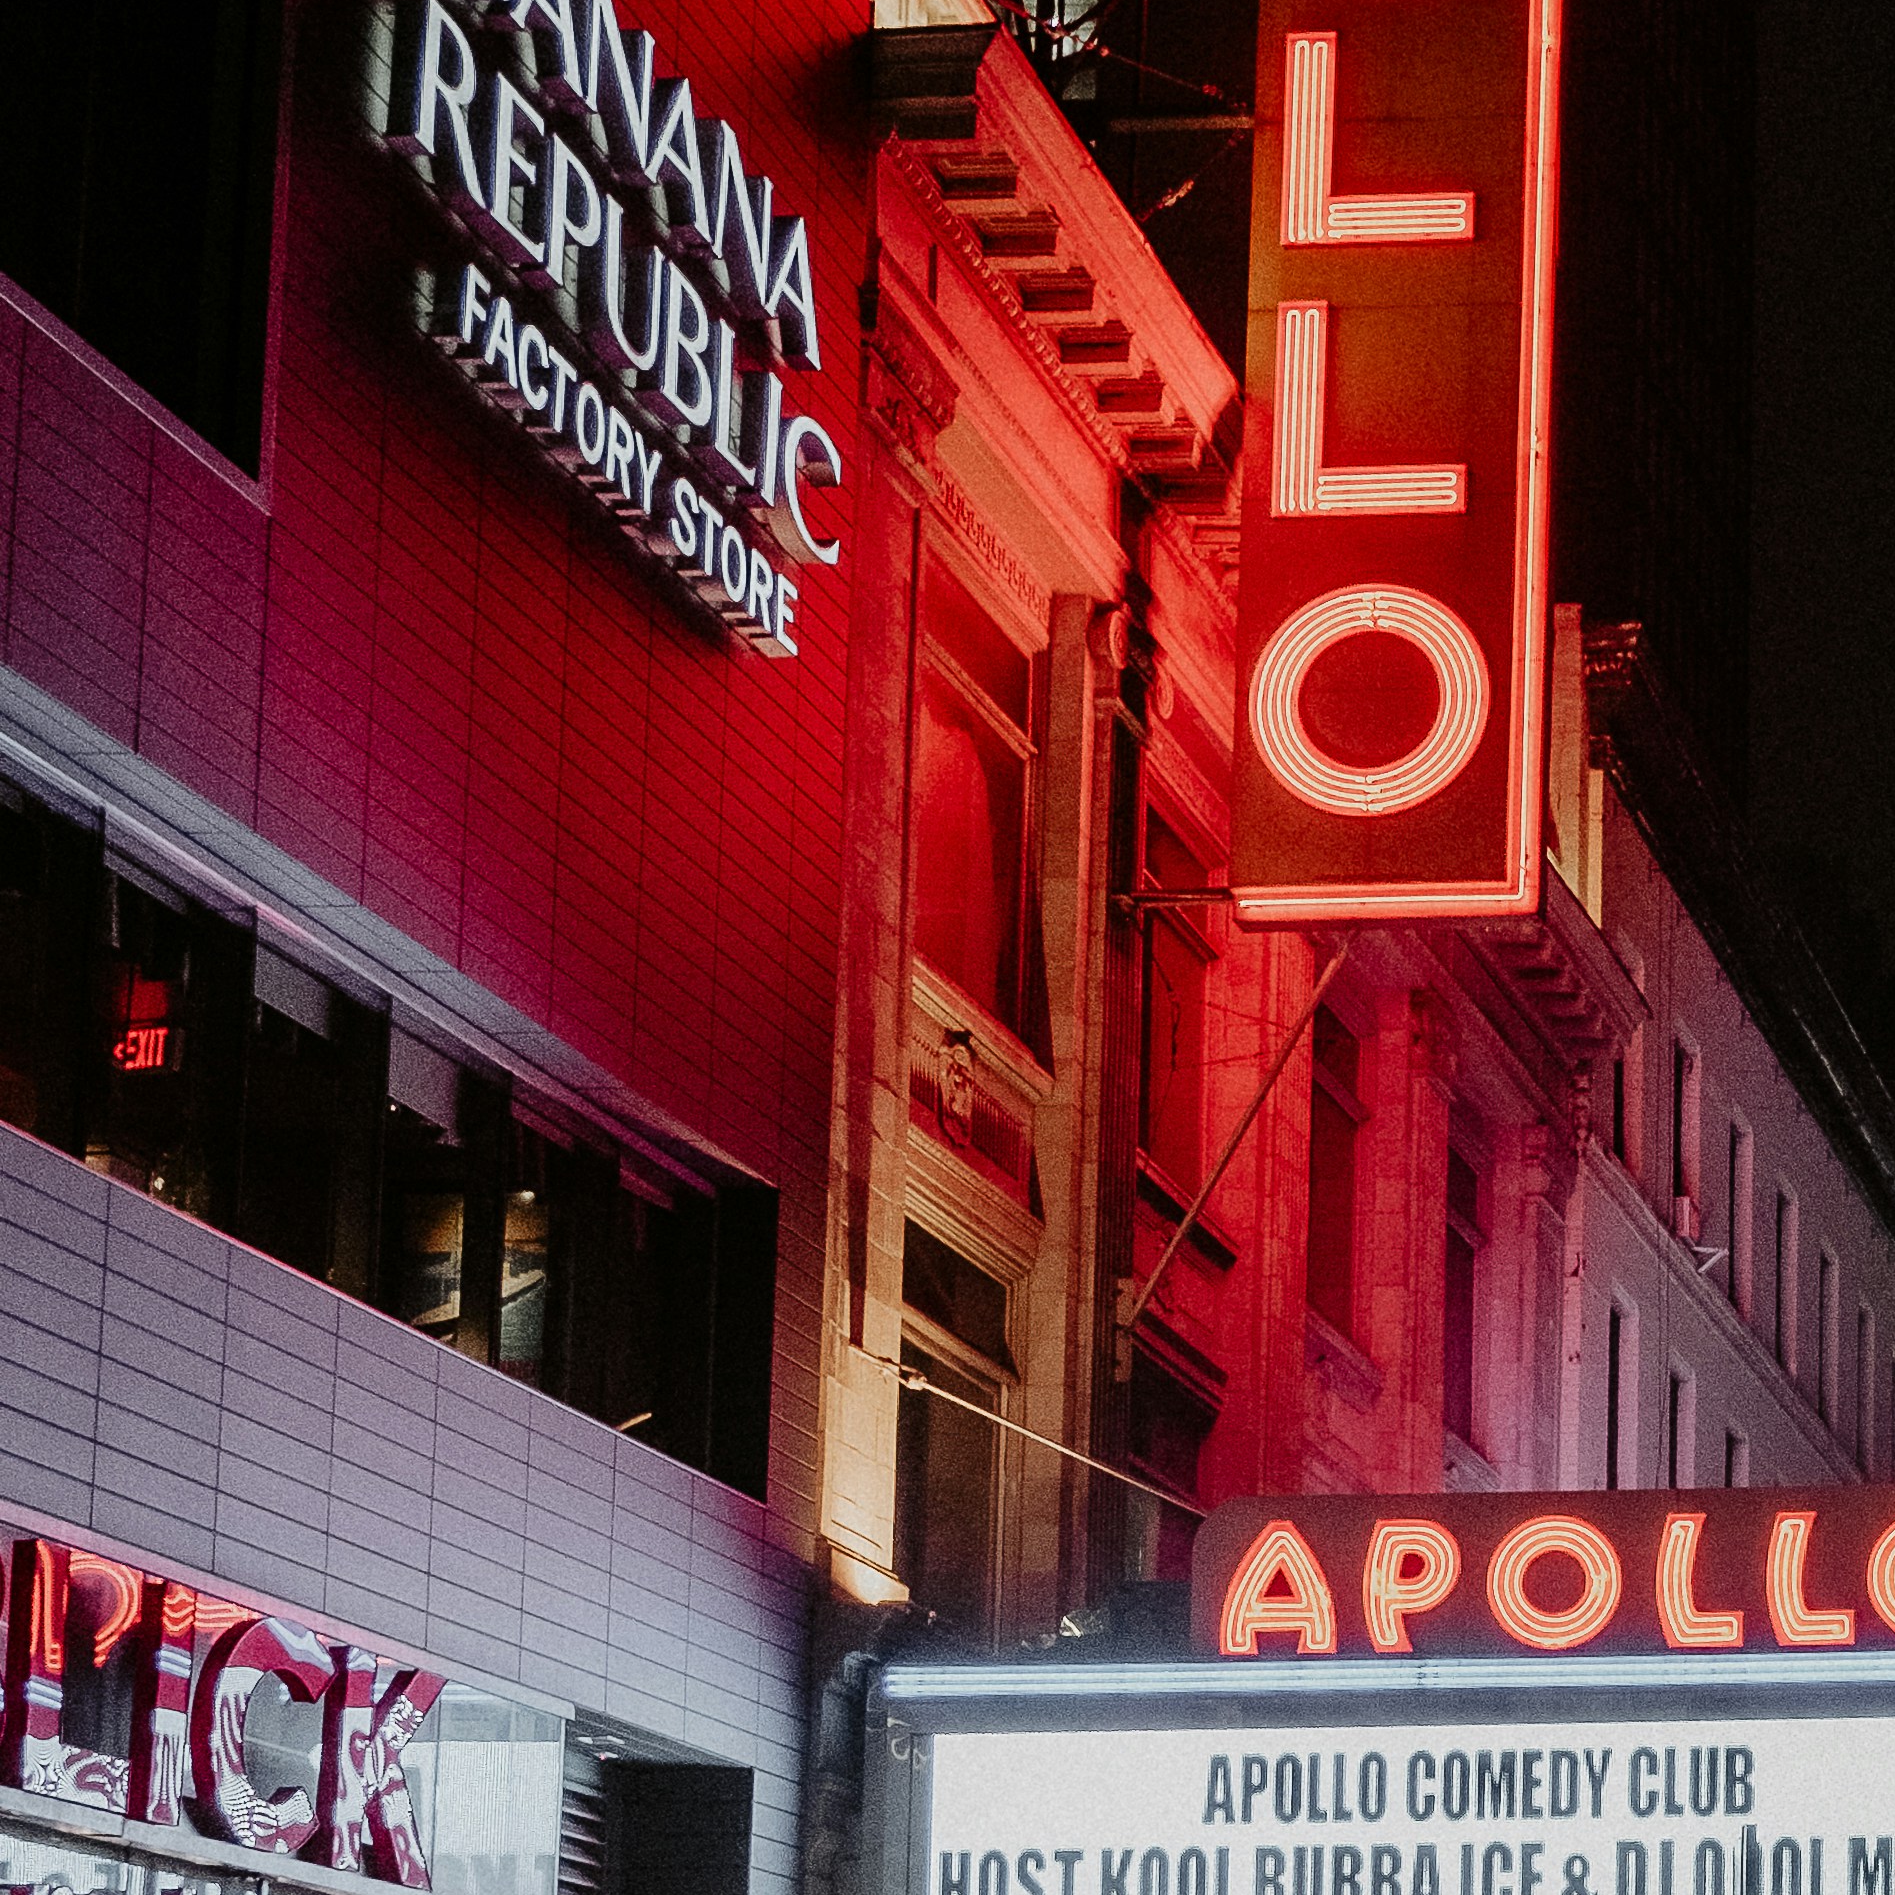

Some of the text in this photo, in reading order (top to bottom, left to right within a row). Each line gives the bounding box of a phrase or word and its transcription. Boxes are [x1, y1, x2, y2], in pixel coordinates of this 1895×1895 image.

[460, 264, 662, 515] FACTORY
[668, 477, 799, 657] STORE
[125, 1027, 169, 1071] EXIT
[0, 1540, 449, 1891] LICK
[1201, 1746, 1756, 1825] APOLLO COMEDY CLUB
